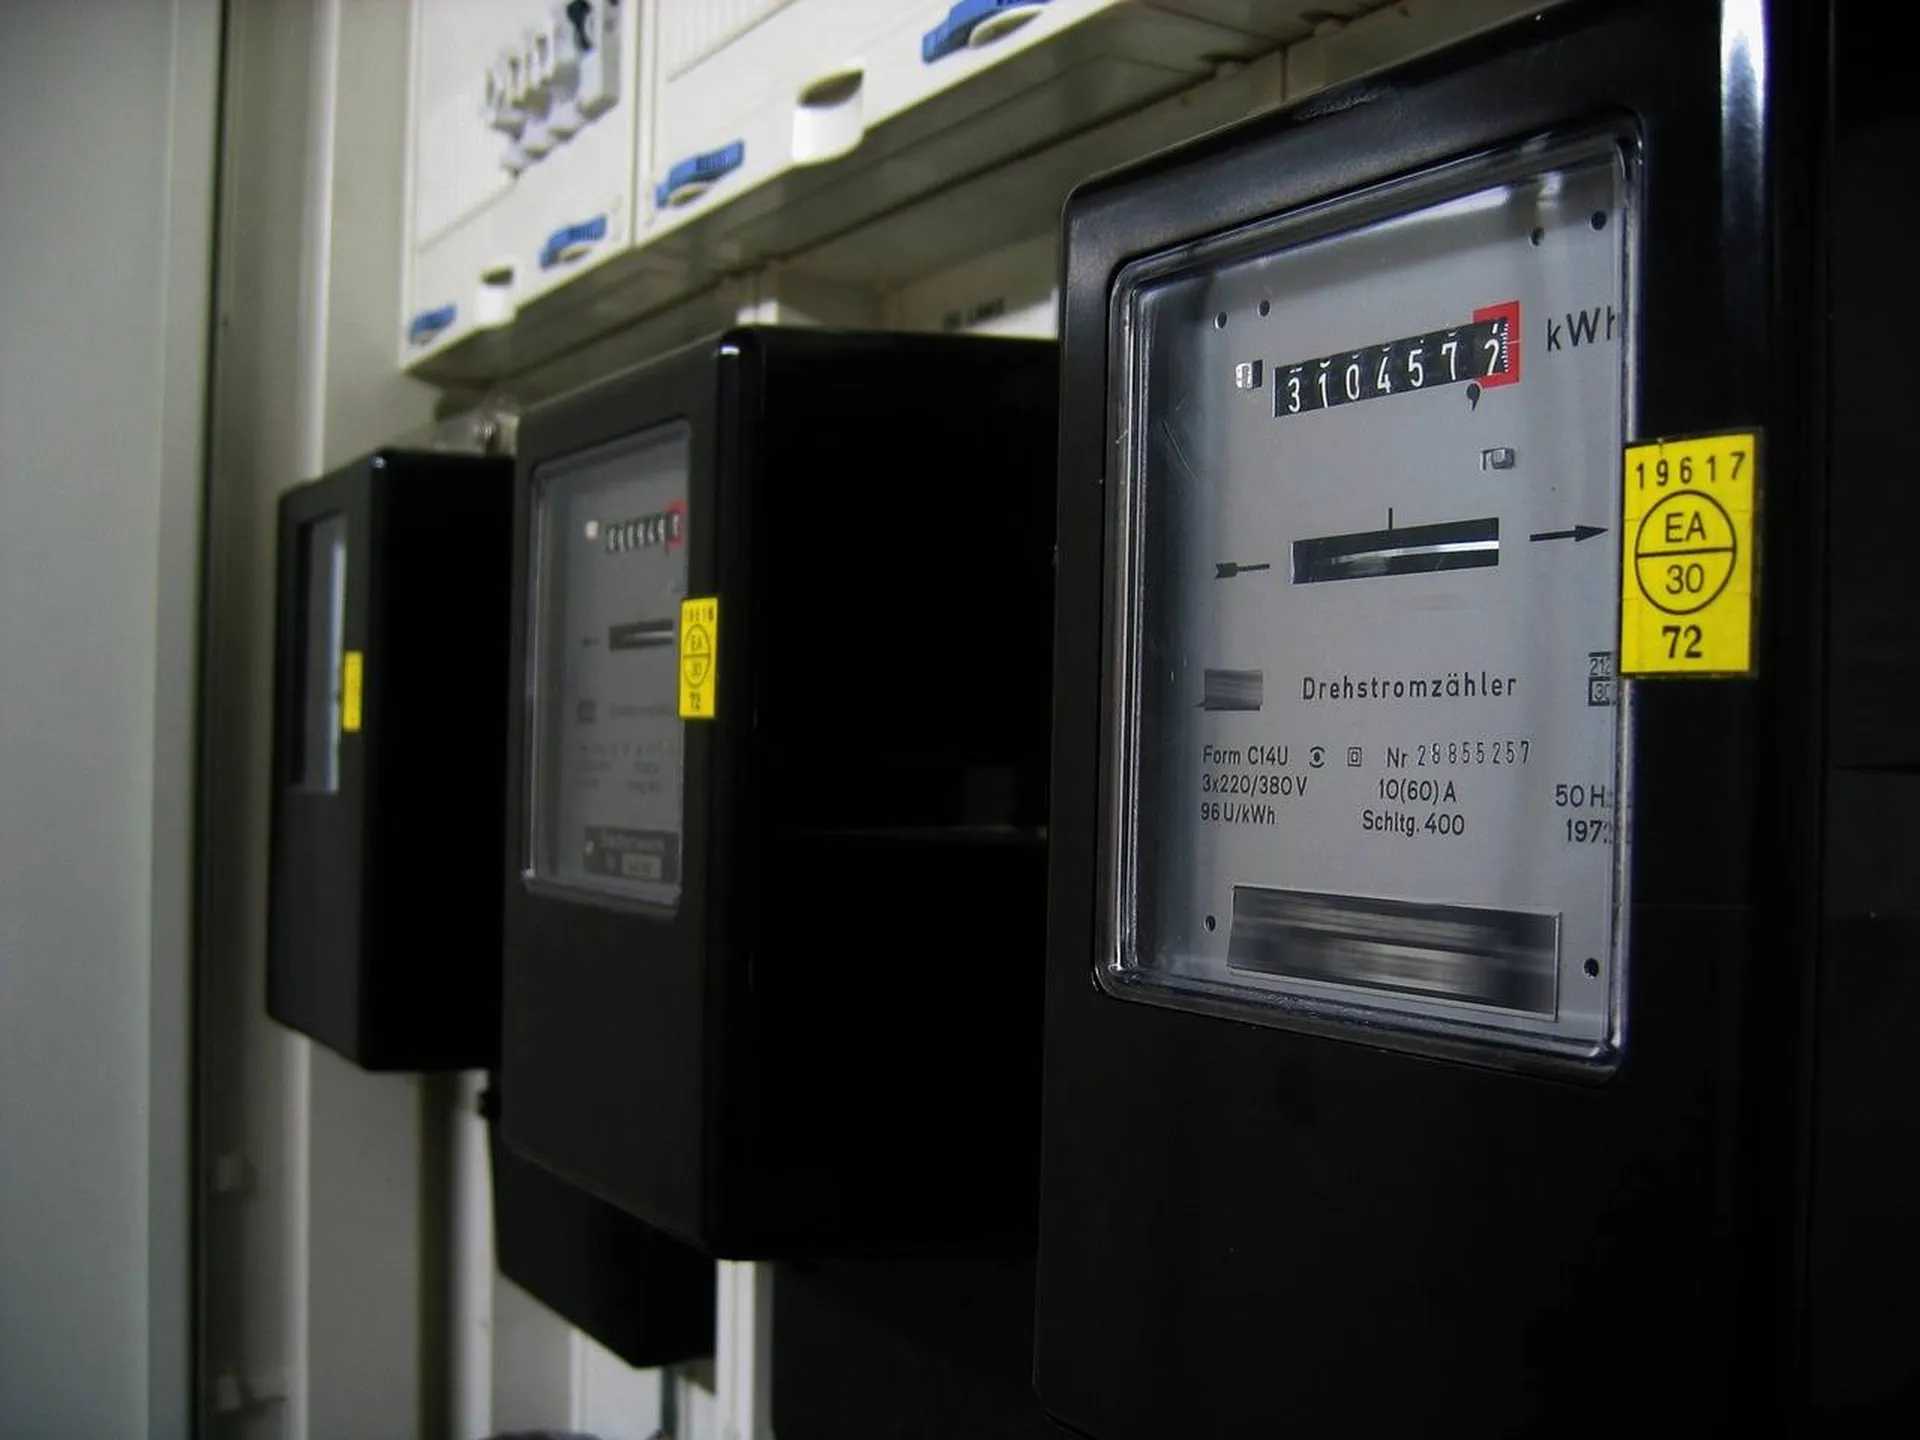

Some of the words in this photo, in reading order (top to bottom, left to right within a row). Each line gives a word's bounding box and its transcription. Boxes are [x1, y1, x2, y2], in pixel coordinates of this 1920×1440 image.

[1635, 451, 1746, 490] 19617
[1665, 511, 1707, 544] EA
[1665, 563, 1705, 596] 30
[1661, 624, 1704, 660] 72
[1302, 671, 1517, 701] Drehstromzähler
[1202, 745, 1241, 766] Form
[1247, 745, 1289, 767] C14U
[1386, 747, 1408, 769] Nr
[1417, 740, 1530, 767] 28855257
[1555, 784, 1585, 808] 50
[1362, 809, 1420, 838] Schltg.
[1424, 813, 1465, 836] 400
